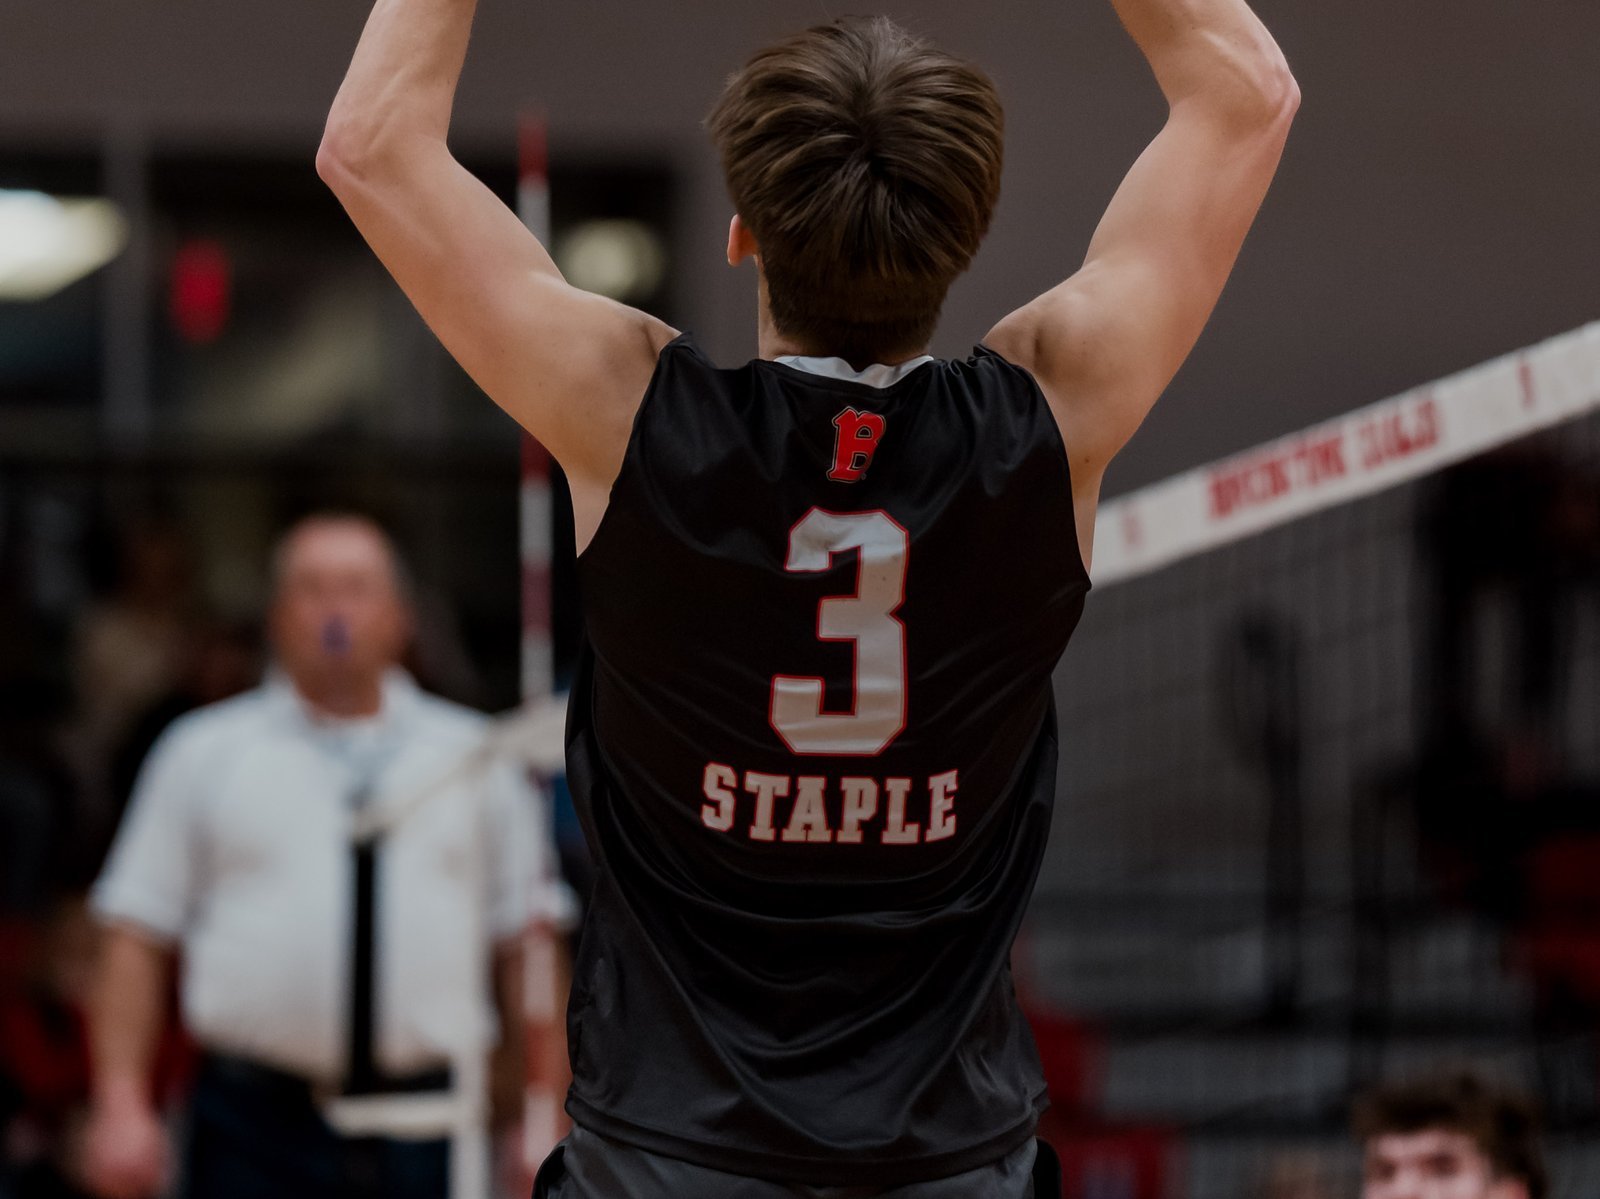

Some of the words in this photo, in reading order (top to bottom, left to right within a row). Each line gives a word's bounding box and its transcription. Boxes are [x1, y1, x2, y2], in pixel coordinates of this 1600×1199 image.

[826, 406, 886, 484] B
[769, 505, 909, 756] 3
[701, 761, 959, 845] STAPLE
